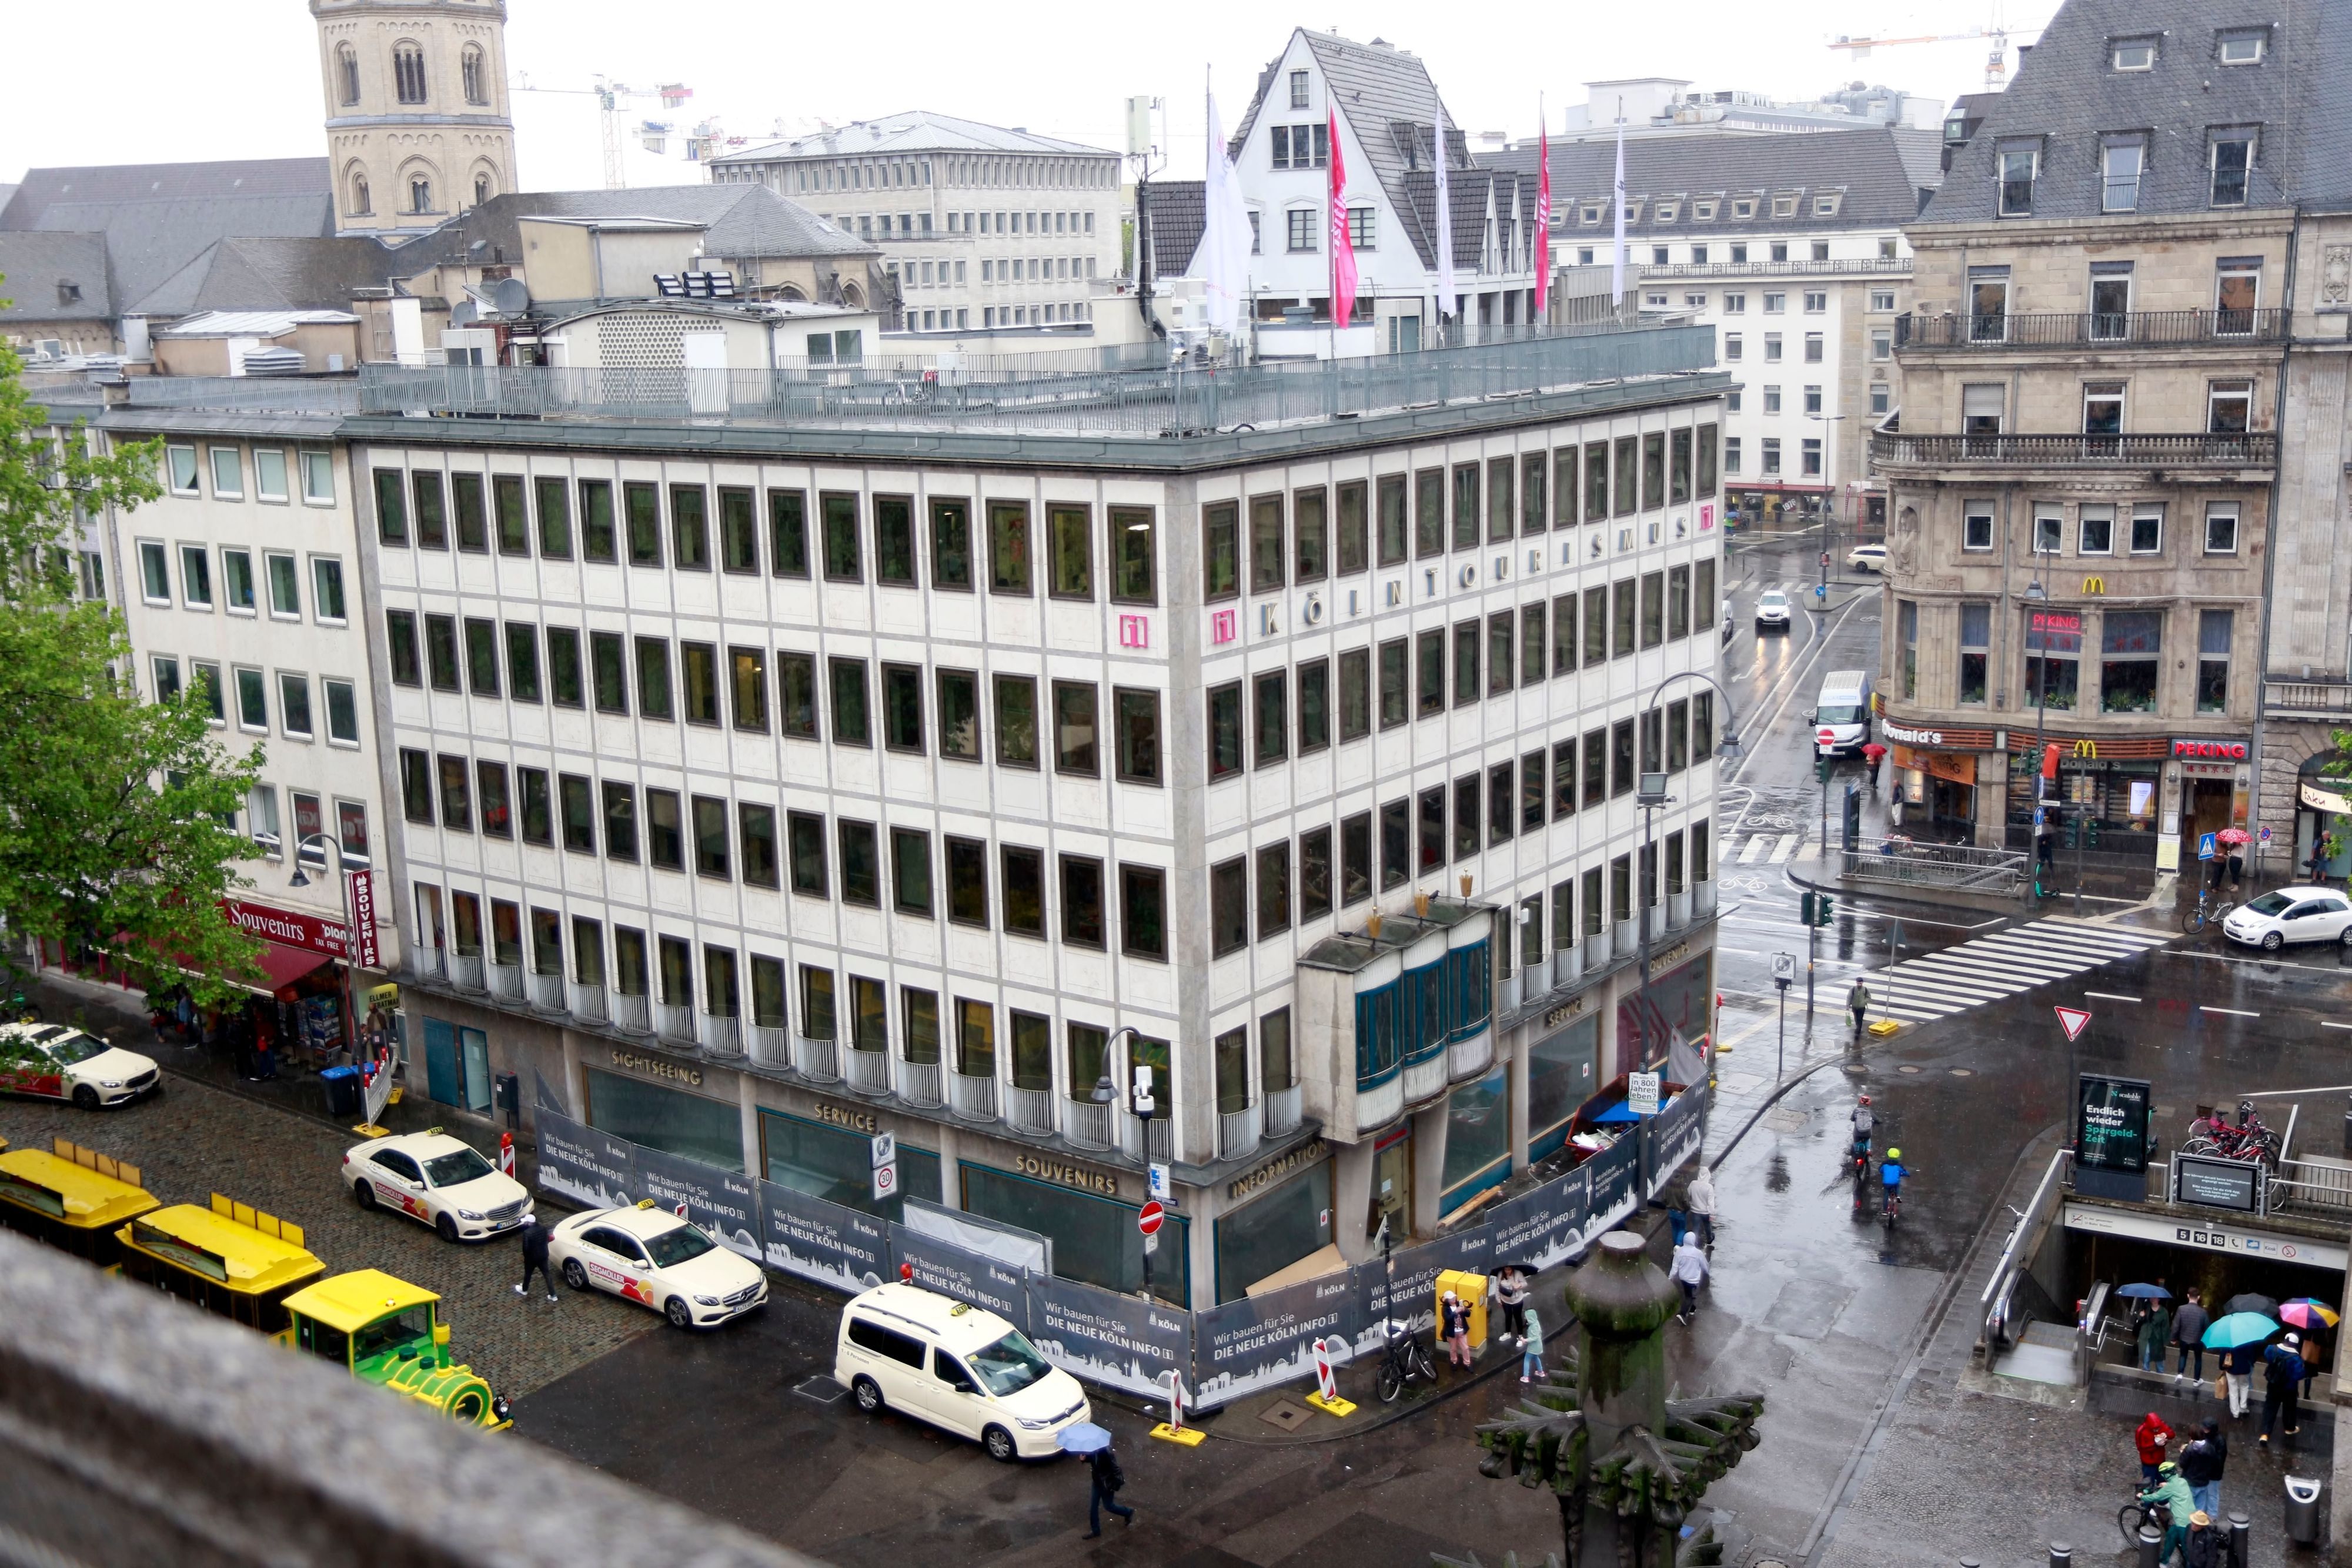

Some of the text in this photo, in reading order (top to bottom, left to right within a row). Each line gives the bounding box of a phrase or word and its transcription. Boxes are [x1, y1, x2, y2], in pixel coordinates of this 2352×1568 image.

[2175, 741, 2245, 758] PEKING
[2304, 788, 2325, 805] taku
[232, 903, 305, 941] Souvenirs
[358, 886, 375, 965] SOUVENIRS
[323, 925, 354, 942] plan
[315, 937, 325, 947] TAX
[327, 941, 340, 951] FREE
[1650, 942, 1690, 972] OUVENIRS
[1548, 998, 1586, 1027] SERVICE
[612, 1051, 702, 1085] SIGHTSEEING
[1630, 1085, 1656, 1094] Jahren
[1630, 1092, 1656, 1100] leben?
[815, 1104, 876, 1131] SERVICE
[2086, 1105, 2124, 1117] Endlich
[2086, 1115, 2123, 1126] wieder
[2085, 1134, 2106, 1144] Zeit
[2086, 1125, 2137, 1138] Spargeld-
[544, 1132, 595, 1159] Wir bauen für Sie
[612, 1148, 626, 1159] KÖLN
[546, 1144, 616, 1179] DIE NEUE KÖLN INFO
[1232, 1140, 1327, 1199] INFORMATION
[881, 1172, 890, 1183] 30
[1016, 1155, 1115, 1193] SOUVENIRS
[647, 1172, 709, 1198] Wir bauen für Sie
[731, 1183, 749, 1195] KÖLN
[880, 1188, 891, 1196] ZONE
[1568, 1181, 1581, 1193] KÖLN
[649, 1184, 735, 1217] DIE NEUE KÖLN INFO
[773, 1208, 837, 1237] Wir bauen für Sie
[860, 1225, 878, 1237] KÖLN
[1496, 1210, 1549, 1241] Wir bauen für Sie
[775, 1221, 864, 1259] DIE NEUE KÖLN INFO
[1495, 1212, 1568, 1255] DIE NEUE KÖLN INFO
[2180, 1231, 2186, 1239] 5
[2195, 1233, 2206, 1242] 16
[2212, 1236, 2223, 1245] 18
[1468, 1238, 1486, 1250] KÖLN
[904, 1252, 971, 1285] Wir bauen für Sie
[997, 1272, 1016, 1285] KÖLN
[1371, 1285, 1386, 1296] Wir
[1415, 1270, 1428, 1281] für
[1429, 1266, 1442, 1278] Sie
[912, 1267, 1000, 1308] IE NEUE KÖLN INFO
[1324, 1283, 1345, 1296] KÖLN
[1371, 1280, 1436, 1311] DIE NEUE KÖL
[956, 1305, 968, 1314] TAXI
[1045, 1301, 1127, 1333] Wir bauen für Sie
[1158, 1319, 1181, 1332] KÖLN
[1214, 1313, 1294, 1345] Wir bauen für Sie
[1046, 1315, 1160, 1357] DIE NEUE KÖLN INFO
[1214, 1316, 1326, 1360] DIE NEUE KÖLN INFO
[850, 1352, 870, 1365] Personen
